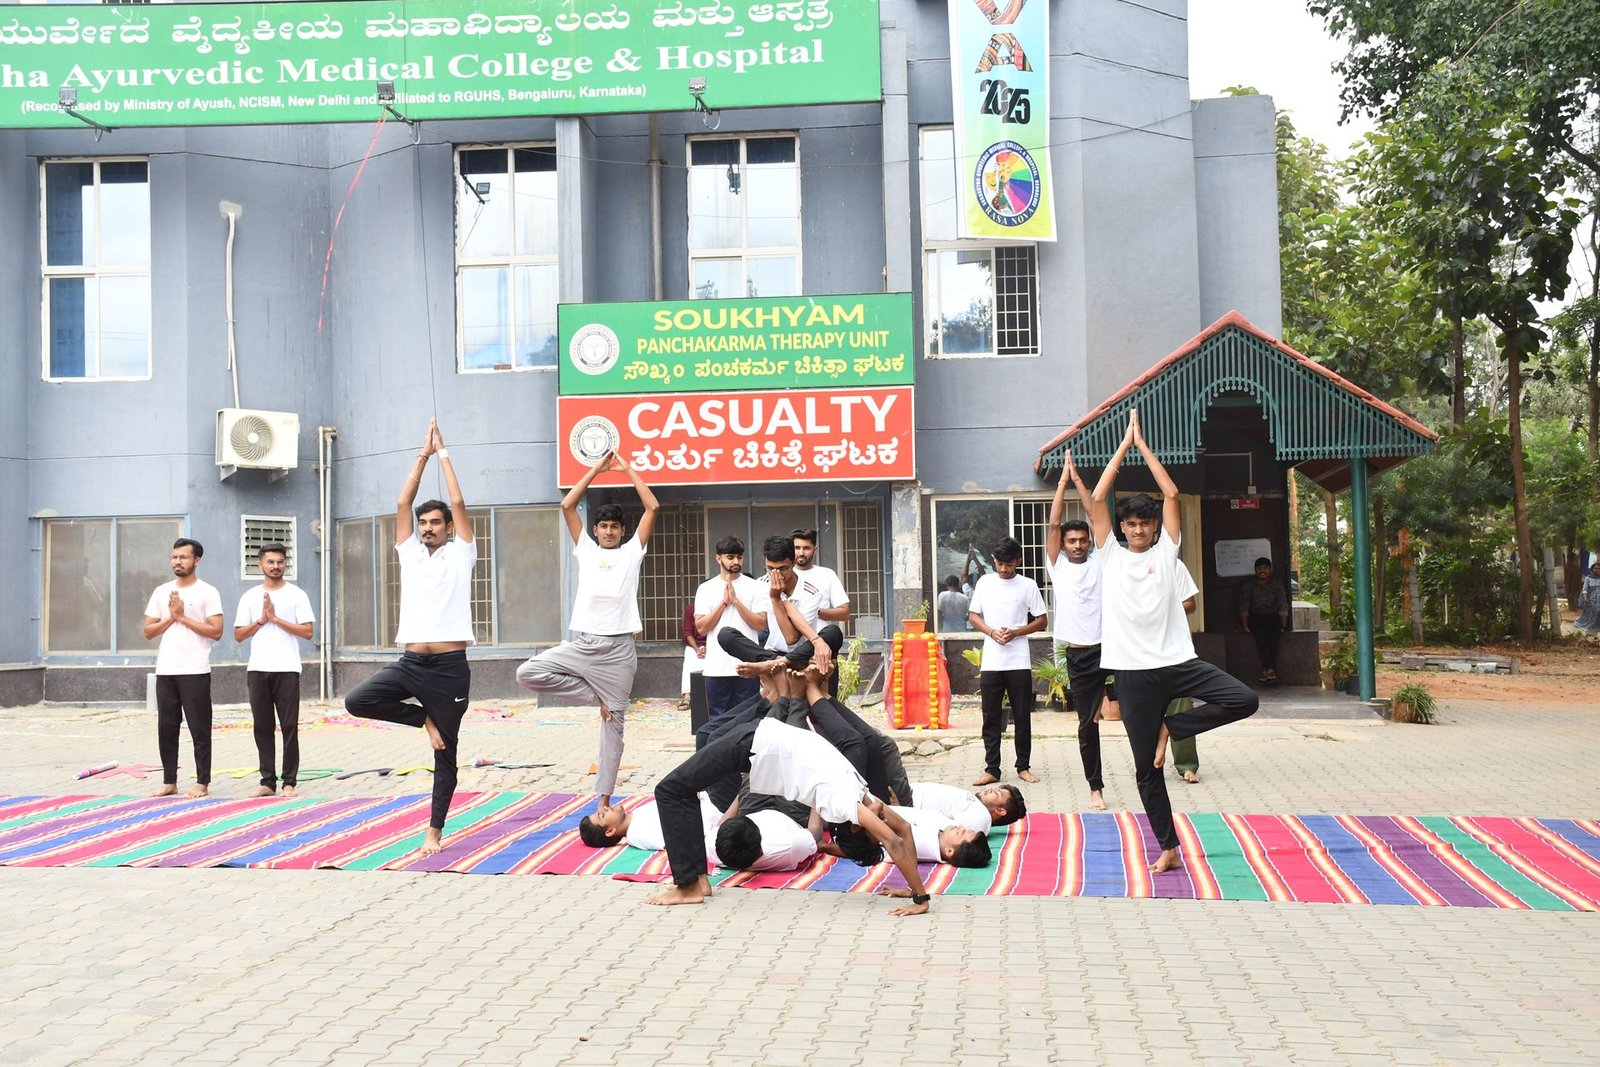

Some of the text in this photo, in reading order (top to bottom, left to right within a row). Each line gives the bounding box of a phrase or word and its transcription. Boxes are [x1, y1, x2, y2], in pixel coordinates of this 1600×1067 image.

[171, 16, 344, 54] ವೈದ್ಯಕೀಯ
[365, 4, 631, 46] ಮಹಾವಿದ್ಯಾಲಯ
[653, 0, 744, 37] ಮತ್ತು
[60, 60, 264, 93] Ayurvedic
[276, 56, 435, 84] Medical
[448, 53, 592, 81] College
[607, 48, 641, 72] &
[656, 39, 824, 74] Hospital
[21, 85, 646, 114] (Recogised by Ministry of Ayush, NCISM, New Delhi and filiated to RGUHS, Bengaluru, Karnataka)
[979, 79, 1031, 124] 2025
[985, 207, 1034, 225] RASA NOVA
[654, 304, 865, 331] SOUKHYAM
[638, 331, 889, 354] PANCHAKARMA THERAPY UNIT
[694, 357, 789, 377] ಪಂಚಕರ್ಮ
[795, 356, 847, 377] ಚಿಕಿತ್ಸಾ
[854, 354, 904, 376] ಘಟಕ
[627, 394, 898, 440] CASUALTY
[630, 437, 898, 474] ತುರ್ತು ಚಿಕಿತ್ಸೆ ಘಟಕ
